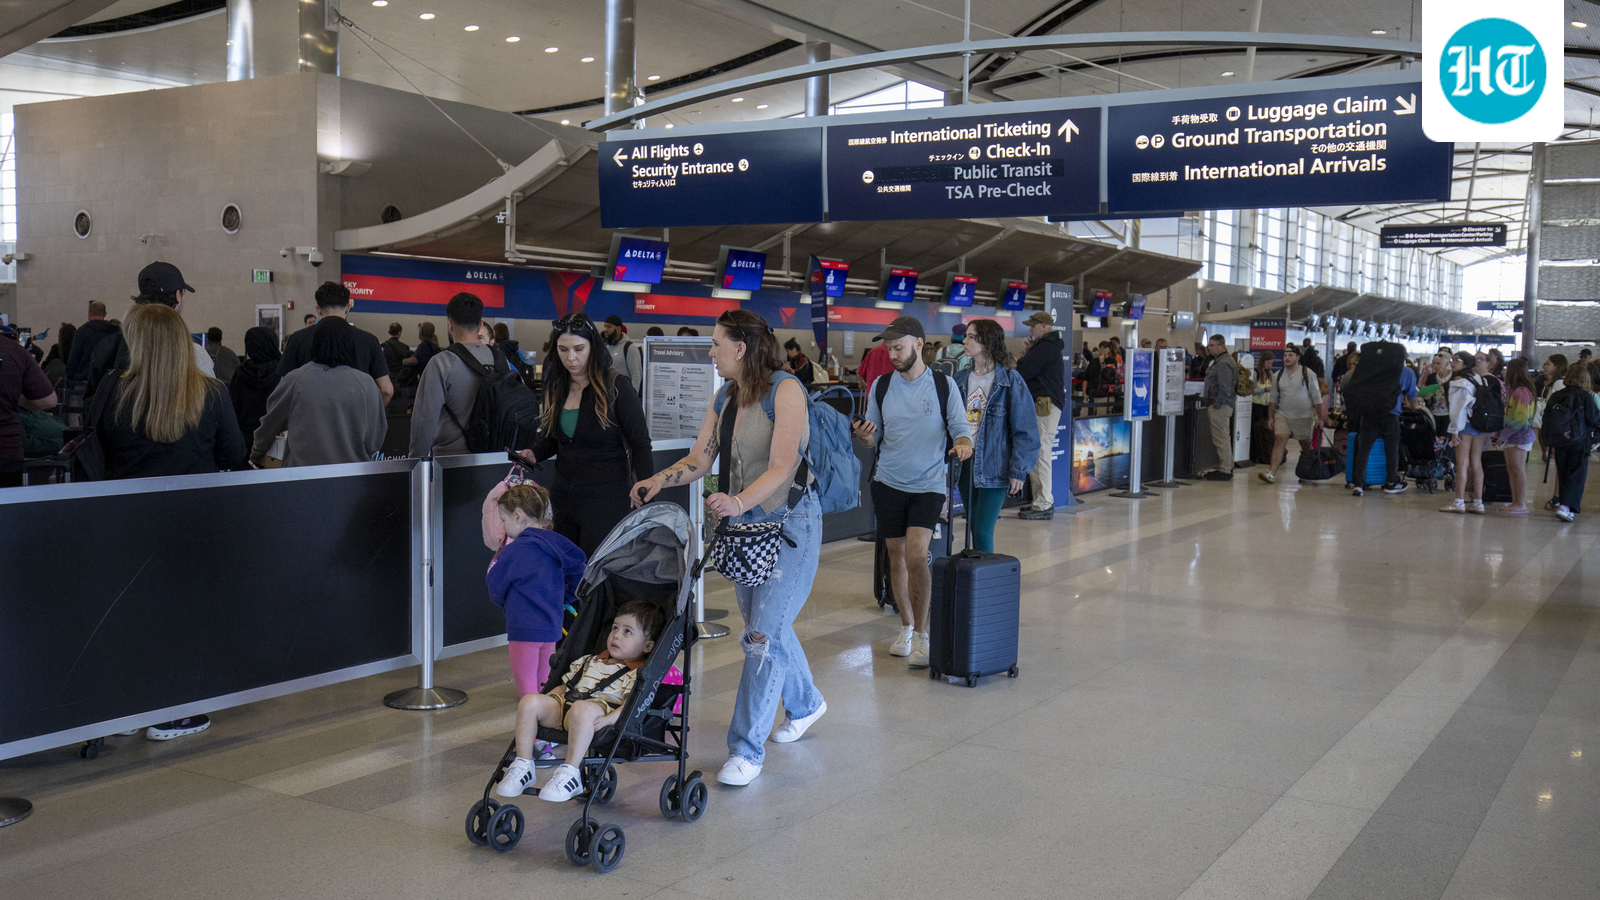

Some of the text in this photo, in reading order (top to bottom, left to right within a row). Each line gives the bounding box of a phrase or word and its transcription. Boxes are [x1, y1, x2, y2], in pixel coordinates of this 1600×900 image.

[1247, 95, 1387, 123] Luggage Claim
[1171, 112, 1219, 126] 手荷物受取
[890, 120, 1051, 144] International Ticketing
[1171, 128, 1239, 148] Ground
[1244, 120, 1387, 145] Transportation
[631, 143, 690, 161] All Flights
[986, 142, 1051, 159] Check-In
[1310, 139, 1387, 154] その他の交通機関
[928, 153, 965, 162] チェックイン
[632, 162, 734, 178] Security Entrance
[954, 162, 1052, 180] Public Transit
[1184, 154, 1387, 180] International Arrivals
[632, 179, 676, 188] セキュリティ入り口
[1132, 170, 1179, 183] 国際線到着
[877, 184, 912, 193] 公共交通機関
[945, 181, 1052, 199] TSA Pre-Check
[632, 250, 655, 259] DELTA
[737, 260, 756, 269] DELTA
[256, 271, 268, 281] EXIT
[473, 271, 498, 280] DELTA
[348, 287, 374, 295] RIORITY
[1055, 291, 1068, 299] DELTA
[635, 691, 655, 718] Jeep
